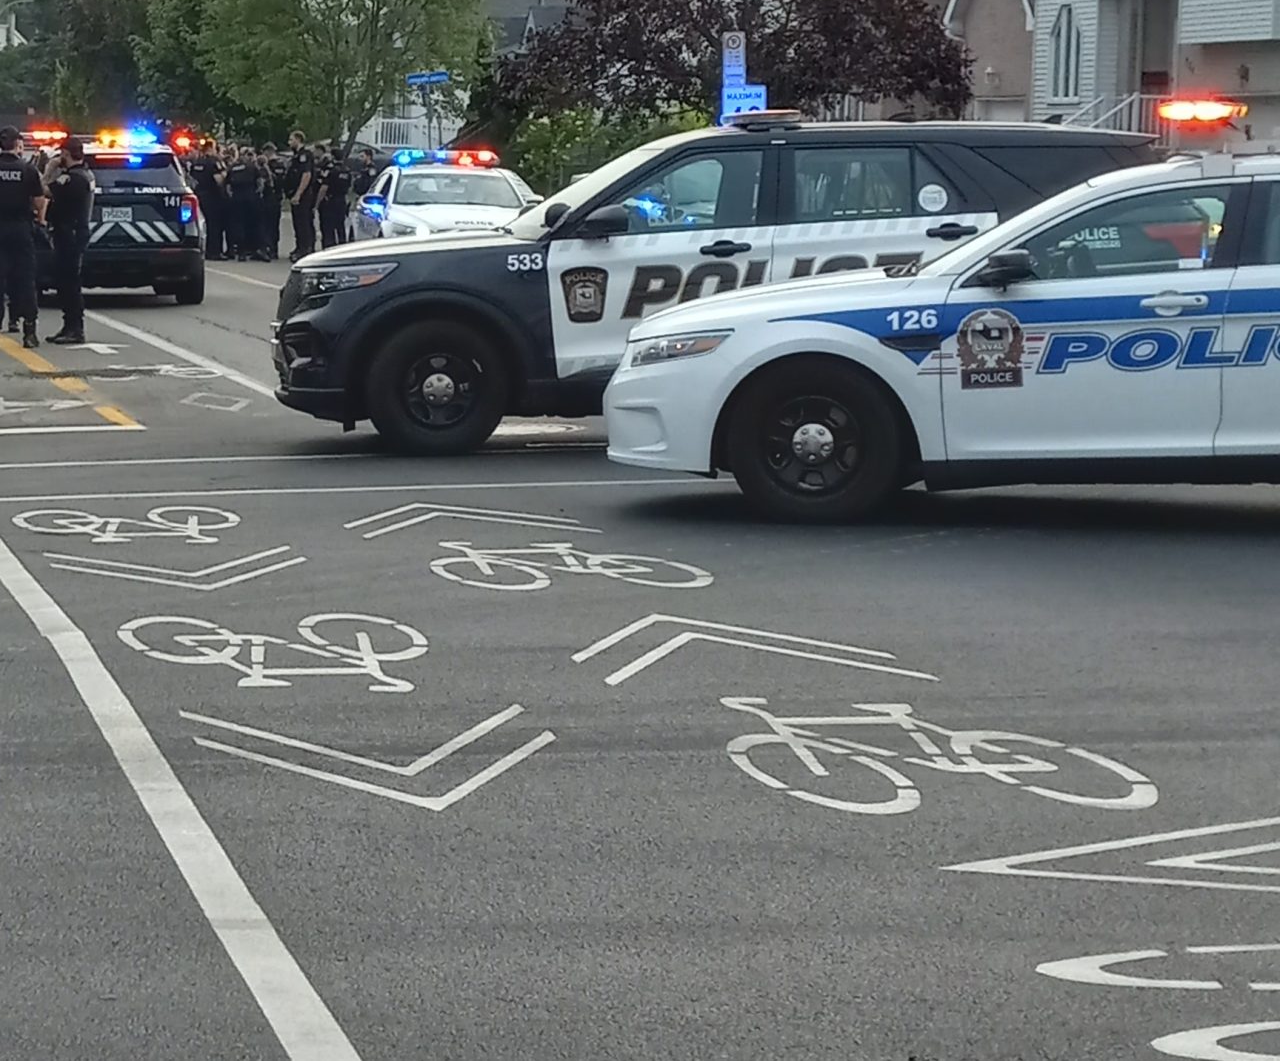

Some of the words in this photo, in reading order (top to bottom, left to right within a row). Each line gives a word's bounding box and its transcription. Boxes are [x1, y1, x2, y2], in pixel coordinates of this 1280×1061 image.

[163, 196, 181, 207] 141
[1070, 226, 1120, 241] OLICE
[507, 253, 544, 271] 533
[564, 272, 605, 285] POLICE
[886, 309, 938, 331] 126
[975, 343, 1004, 352] LAVAL
[1036, 324, 1280, 374] POLI
[971, 371, 1014, 385] POLICE
